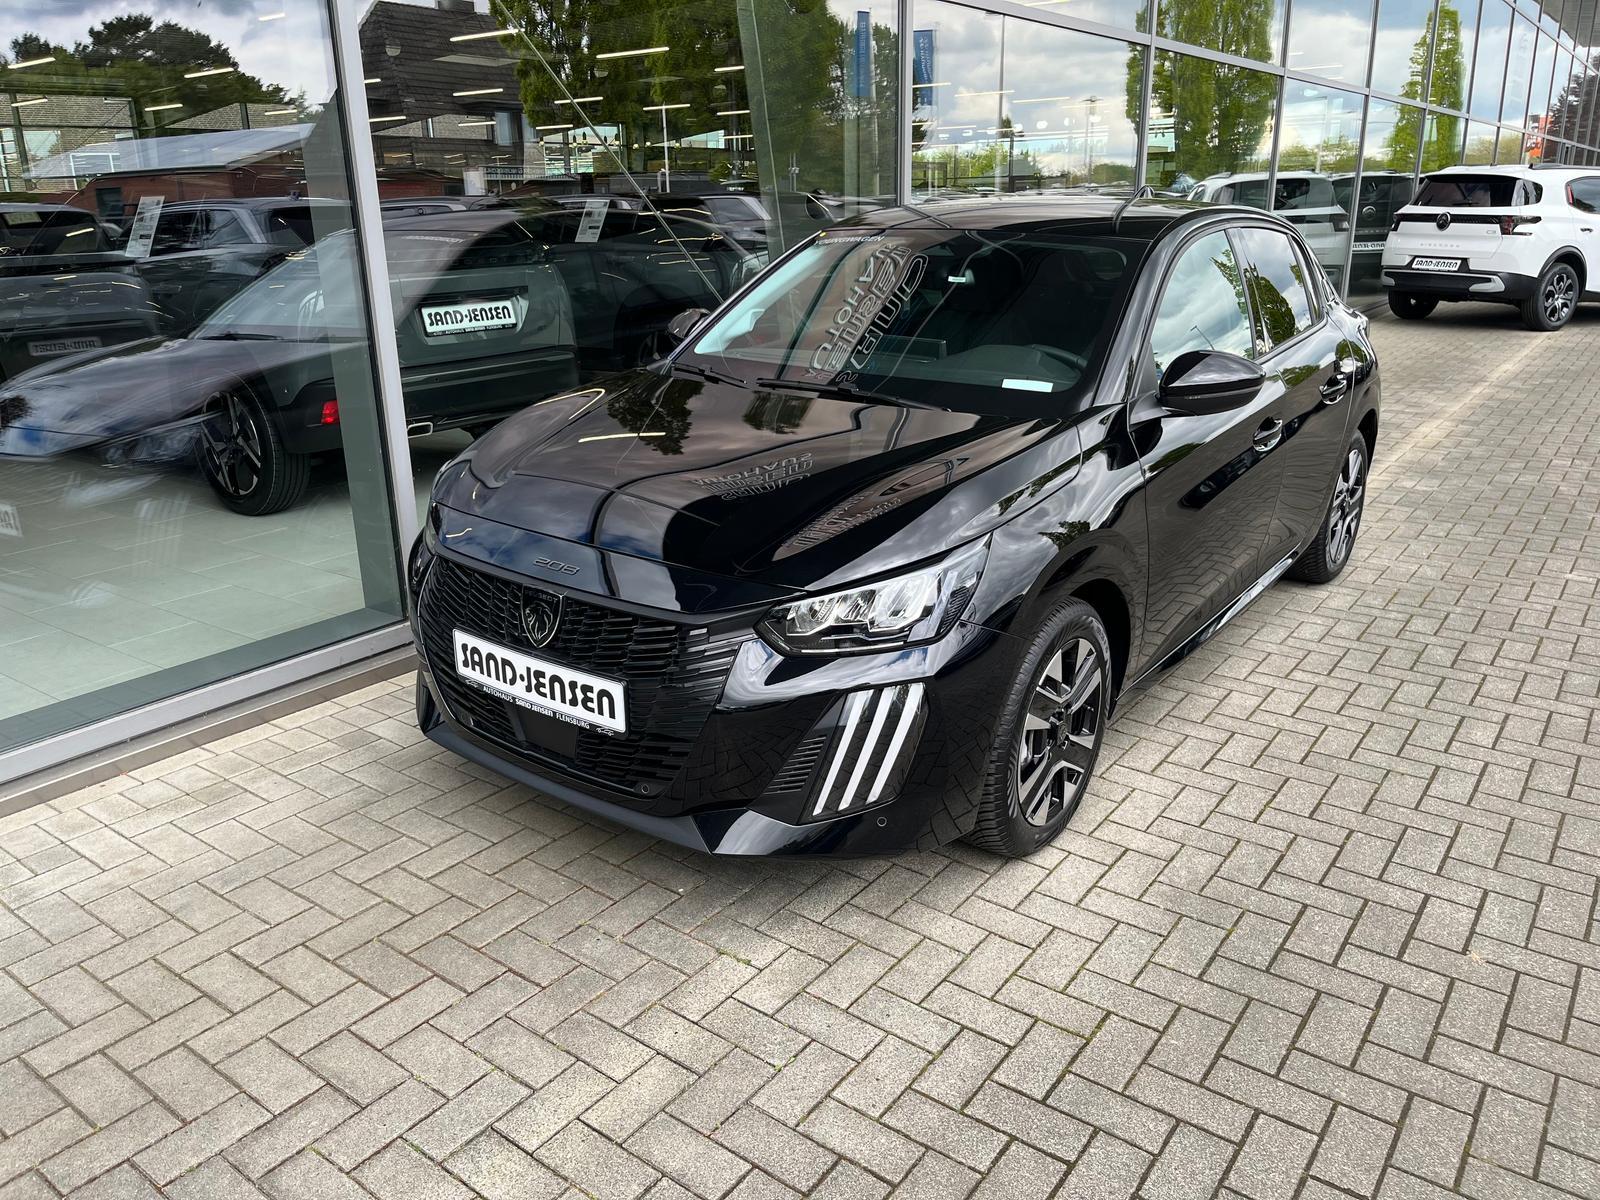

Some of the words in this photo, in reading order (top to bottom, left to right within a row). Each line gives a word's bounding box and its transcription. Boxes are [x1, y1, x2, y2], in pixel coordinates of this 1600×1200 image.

[533, 556, 580, 576] 208
[483, 686, 514, 703] AUTOHAUS
[515, 698, 532, 710] SAND
[531, 705, 554, 718] JENSEN
[556, 712, 590, 729] FLENSBURG
